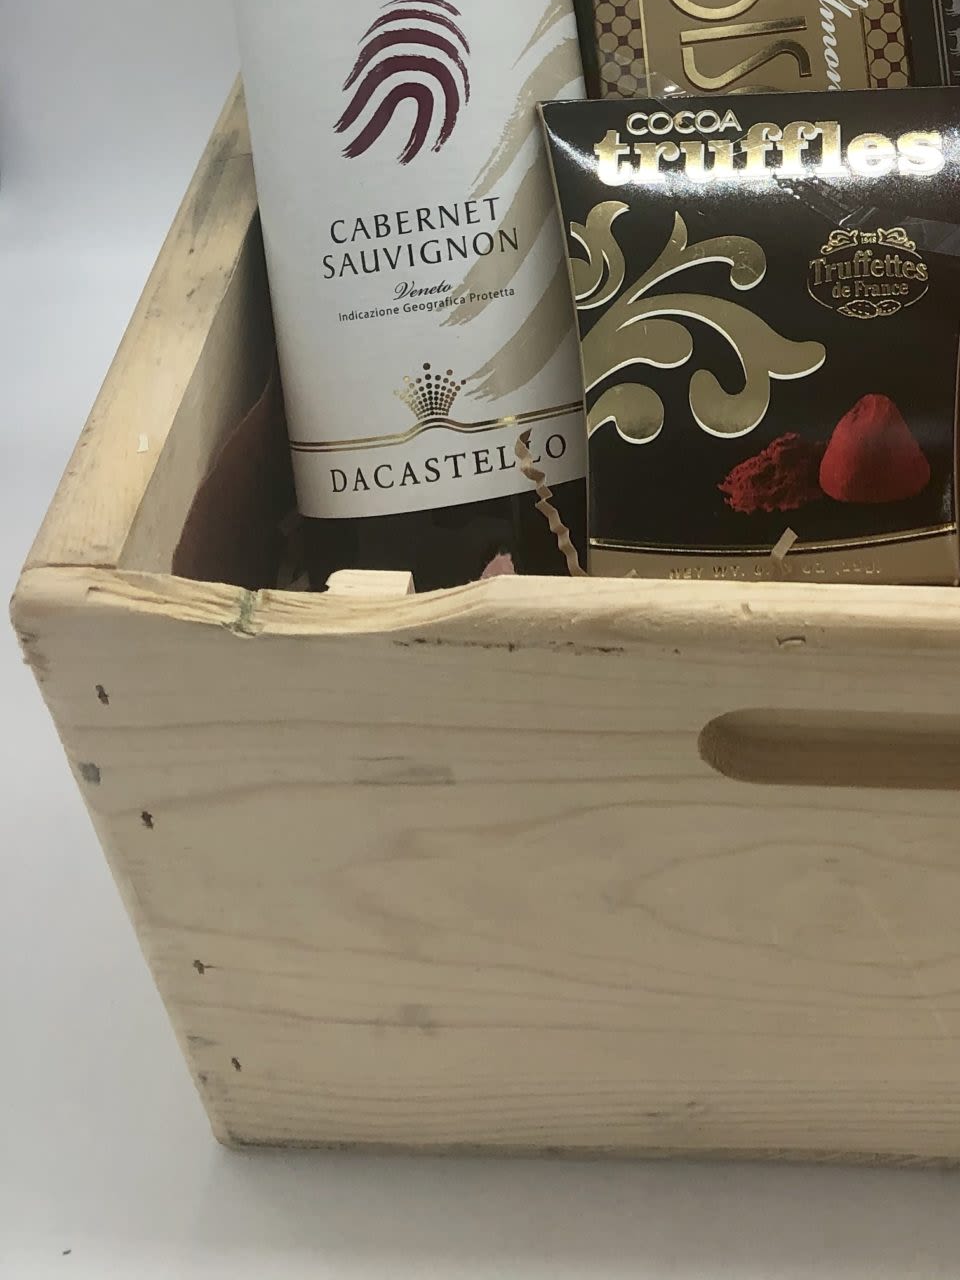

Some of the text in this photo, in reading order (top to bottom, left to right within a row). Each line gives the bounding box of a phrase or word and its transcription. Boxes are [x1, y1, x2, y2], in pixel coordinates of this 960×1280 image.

[625, 108, 744, 136] COCOA
[594, 120, 948, 187] truffles
[329, 196, 500, 245] CABERNET
[322, 227, 519, 279] SAUVIGNON
[808, 249, 929, 286] Truffettes
[338, 286, 516, 322] Indicazione Geografica Protetta
[392, 279, 453, 301] Veneto
[831, 280, 910, 298] de France
